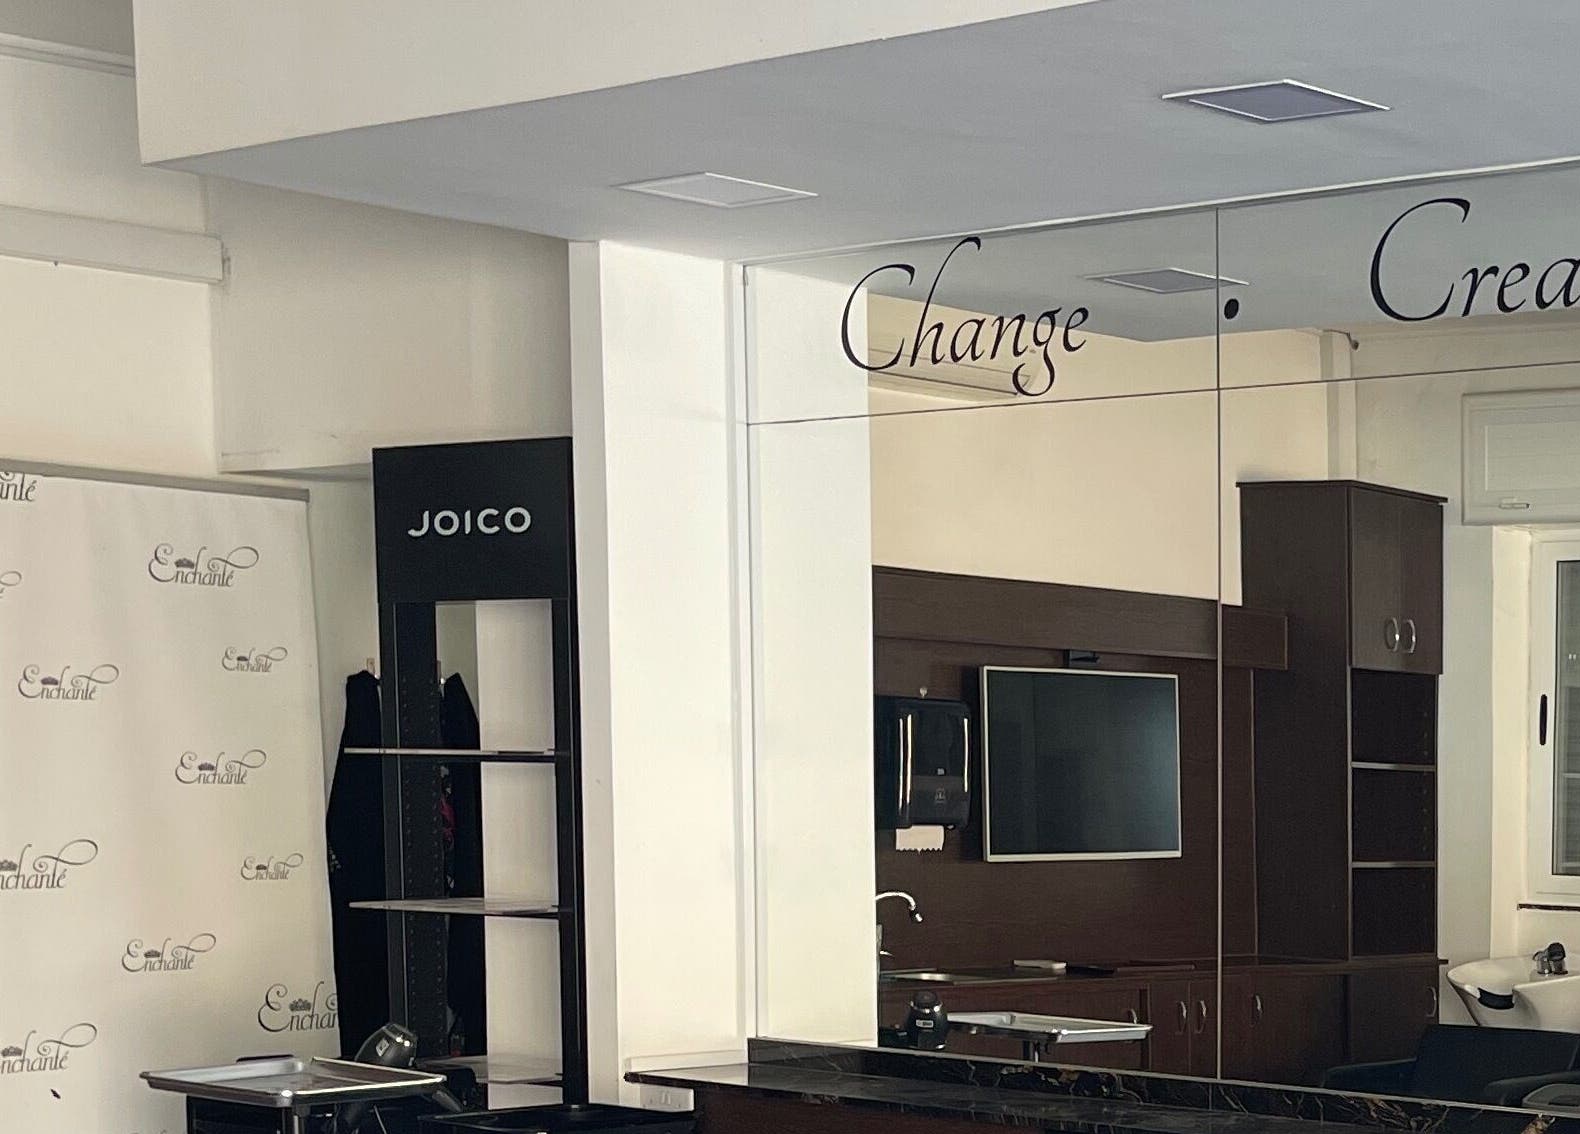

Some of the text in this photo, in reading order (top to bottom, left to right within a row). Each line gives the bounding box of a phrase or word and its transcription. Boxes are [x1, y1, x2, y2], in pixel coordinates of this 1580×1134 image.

[841, 236, 1090, 397] Change
[407, 507, 532, 537] JOICO
[148, 543, 260, 588] Enchanté
[18, 664, 120, 701] Enchanté
[175, 749, 267, 786] Enchanté
[121, 933, 217, 972] Enchanté
[0, 1022, 98, 1075] nchanté
